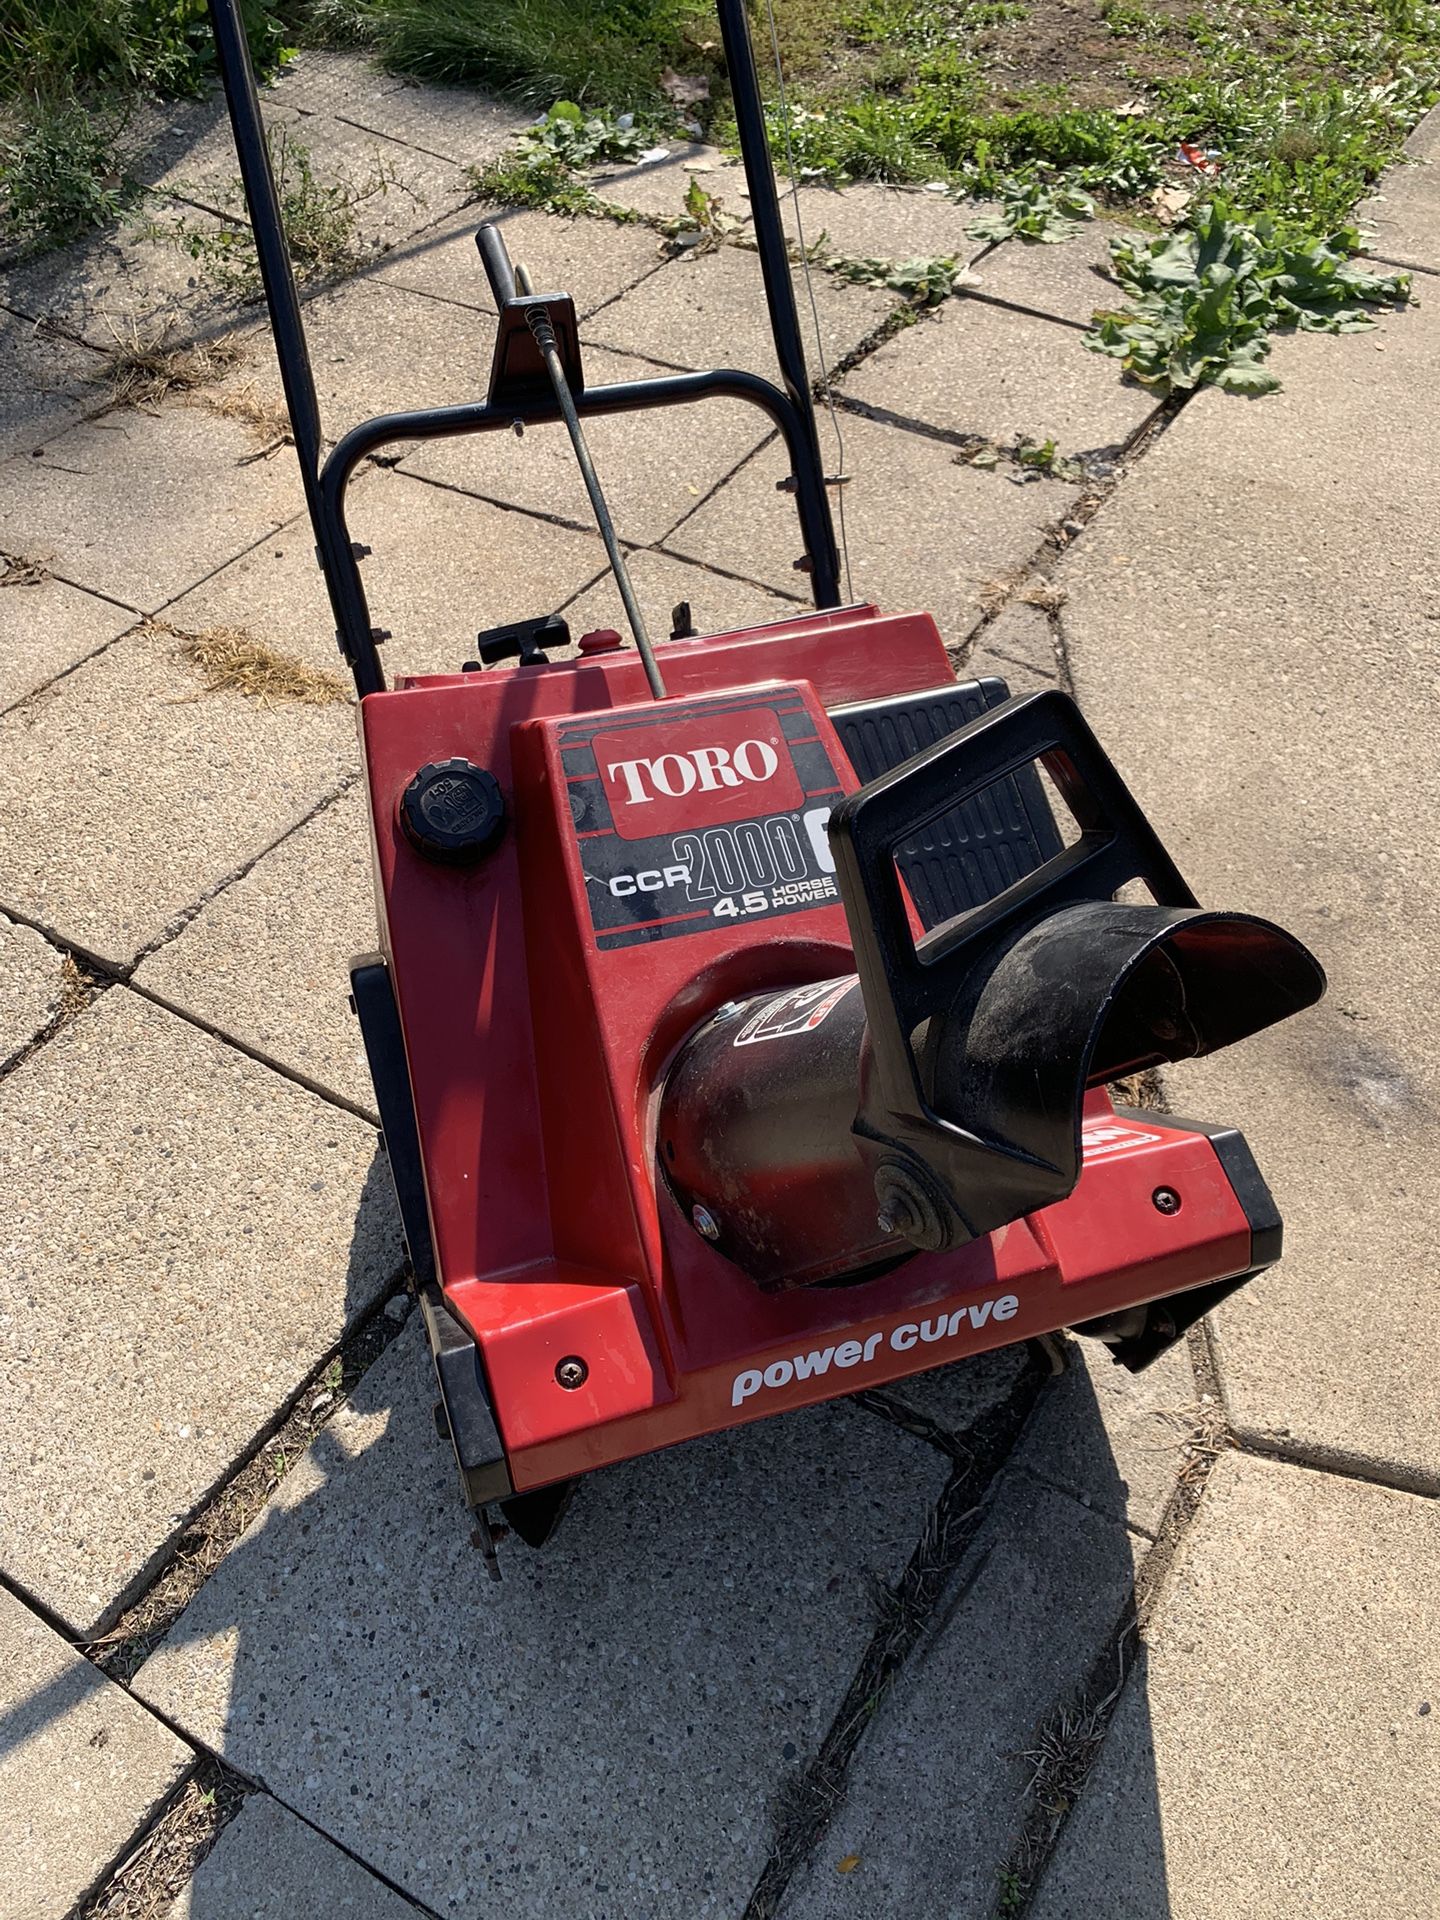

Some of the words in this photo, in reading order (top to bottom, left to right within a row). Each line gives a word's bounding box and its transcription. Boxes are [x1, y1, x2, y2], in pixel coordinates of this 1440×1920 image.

[607, 739, 779, 805] TORO
[608, 863, 693, 897] CCR
[672, 816, 808, 902] 2000
[712, 891, 769, 918] 4.5
[771, 887, 838, 909] POWER
[772, 876, 835, 898] HORSE
[731, 1332, 883, 1406] power
[890, 1294, 1019, 1351] curve
